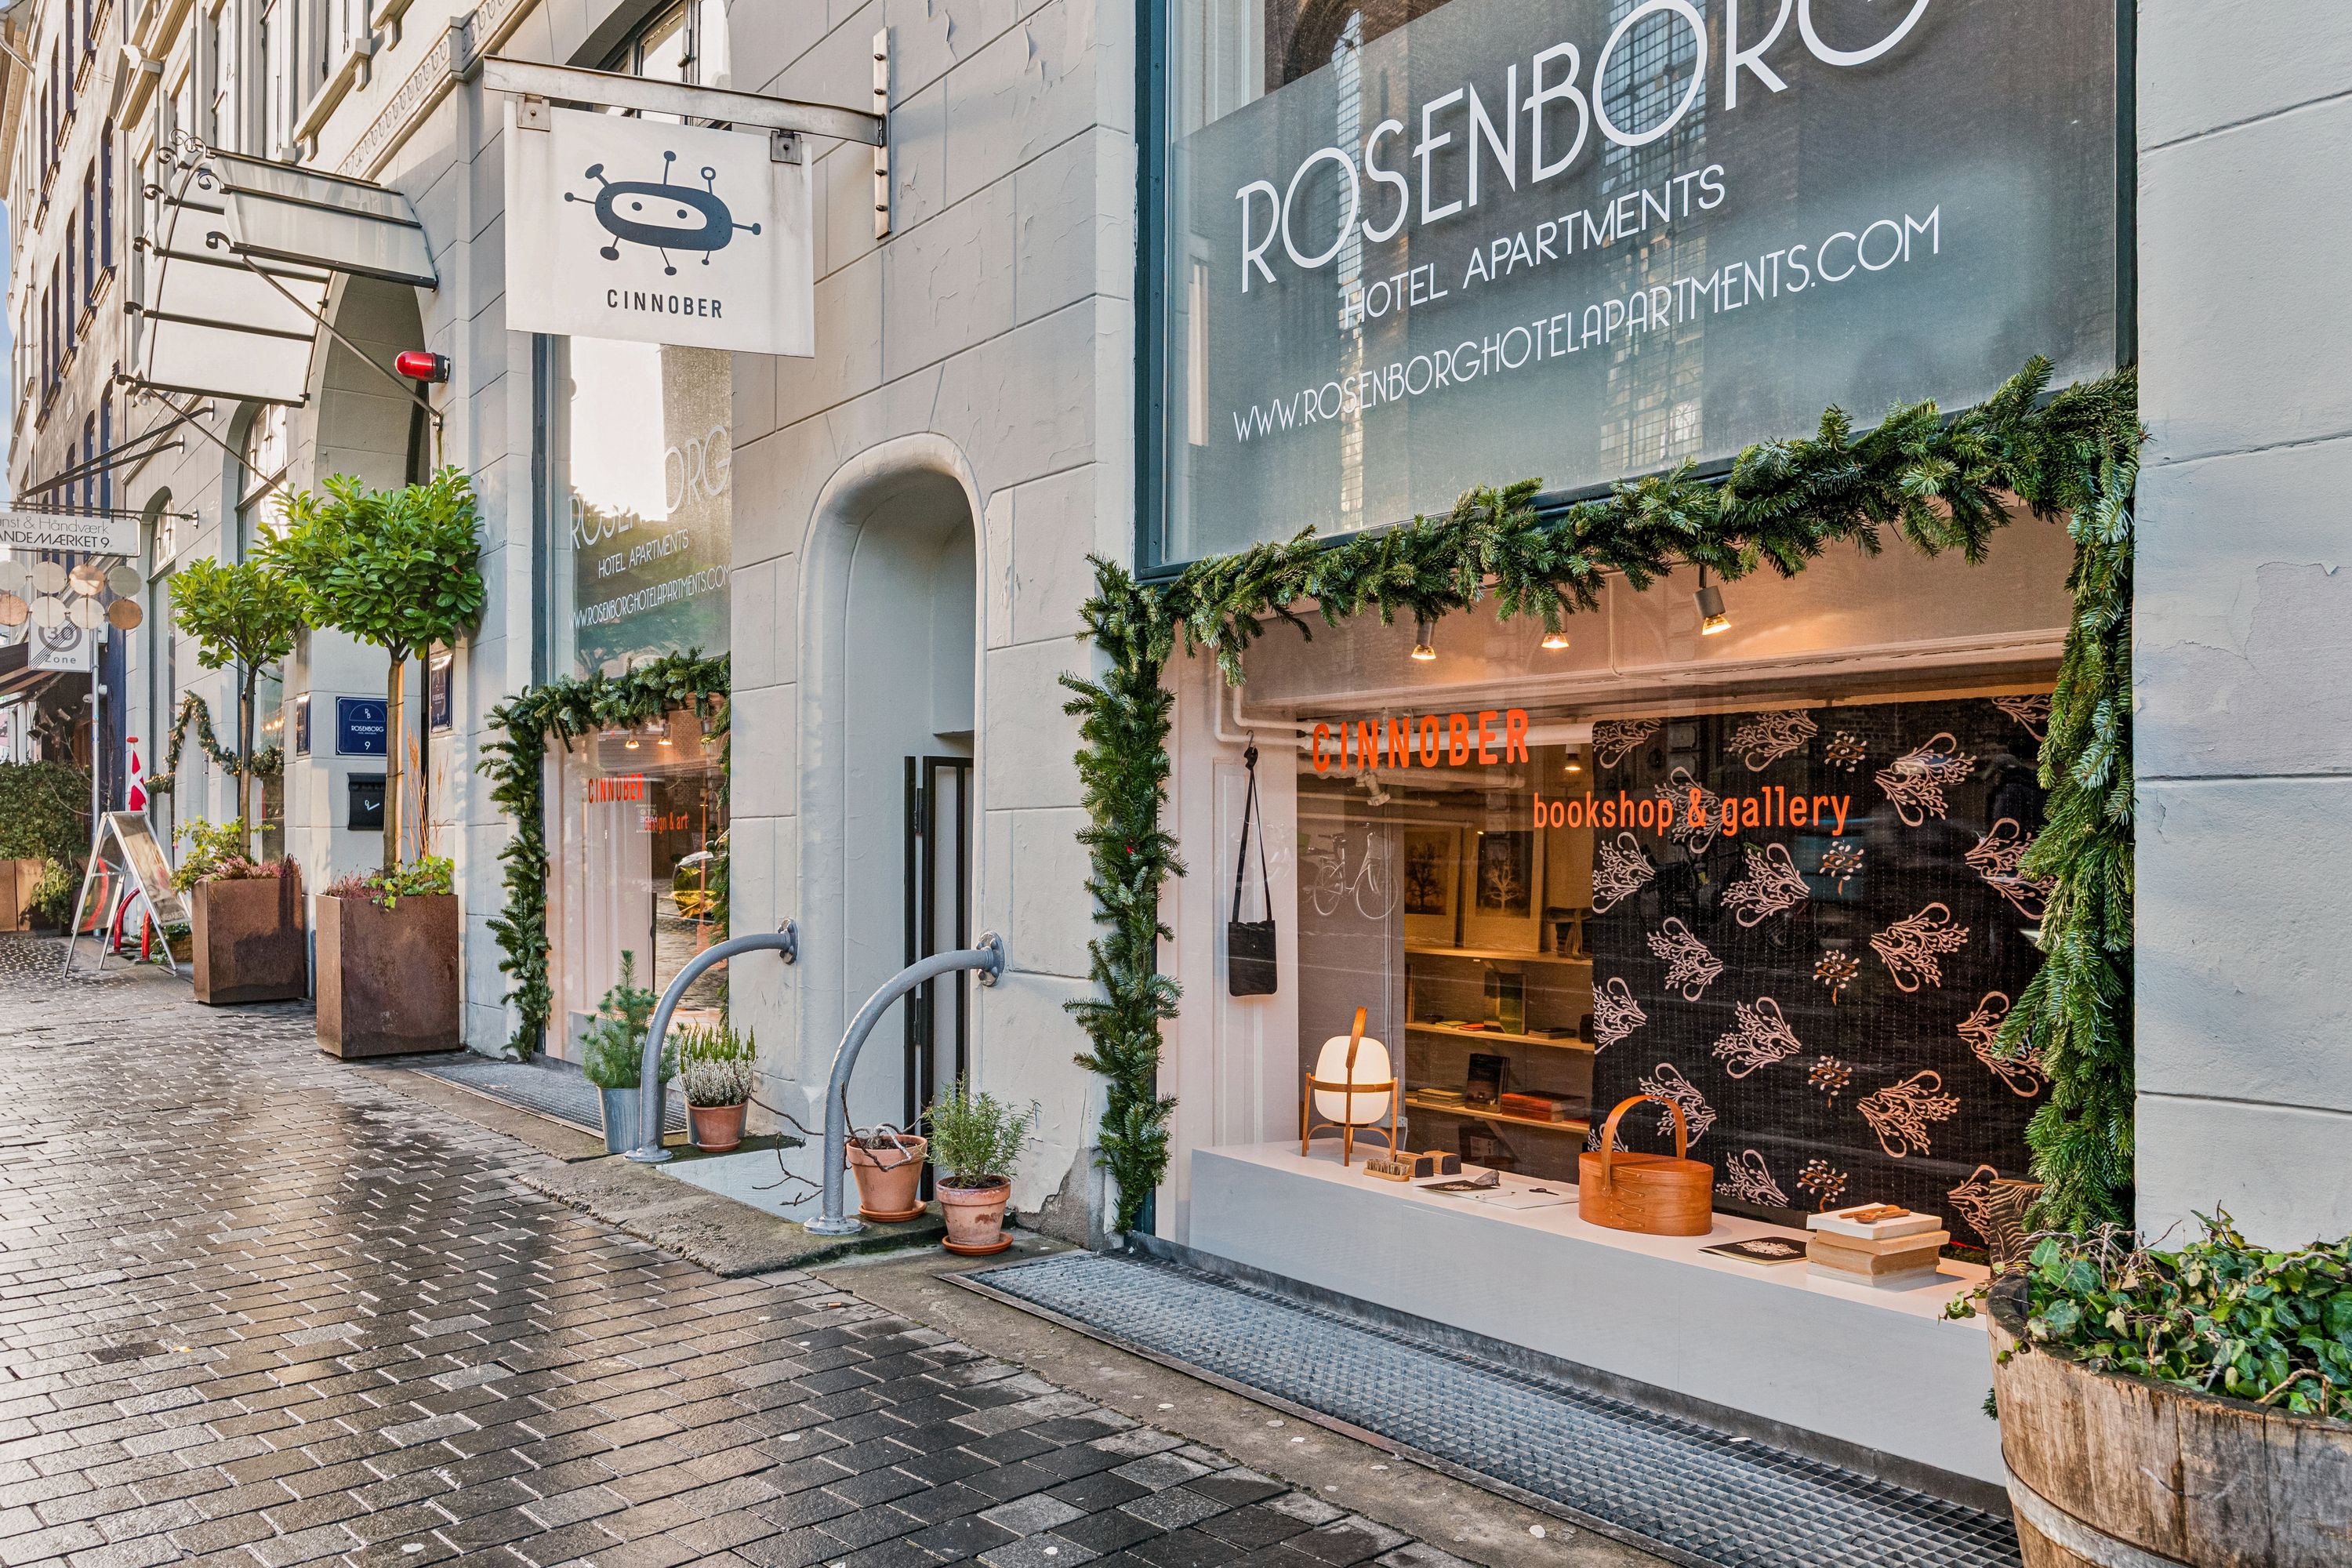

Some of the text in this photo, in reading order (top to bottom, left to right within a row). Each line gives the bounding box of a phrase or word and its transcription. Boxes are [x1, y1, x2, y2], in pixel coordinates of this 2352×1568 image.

[1343, 164, 1726, 328] HOTEL APARTMENTS
[607, 289, 722, 318] CINNOBER
[1232, 204, 1940, 443] WWW.ROSENBORGHOTELAPARTMENTS.COM
[24, 515, 36, 529] &
[39, 517, 109, 535] Håndværk
[100, 536, 110, 549] 9
[598, 528, 690, 579] HOTEL APARTMENTS
[45, 654, 77, 664] Zone
[365, 741, 371, 750] 9
[1312, 709, 1529, 772] CINNOBER
[588, 771, 644, 804] CINNOBER
[676, 811, 688, 831] art
[1534, 786, 1851, 837] bookshop & gallery
